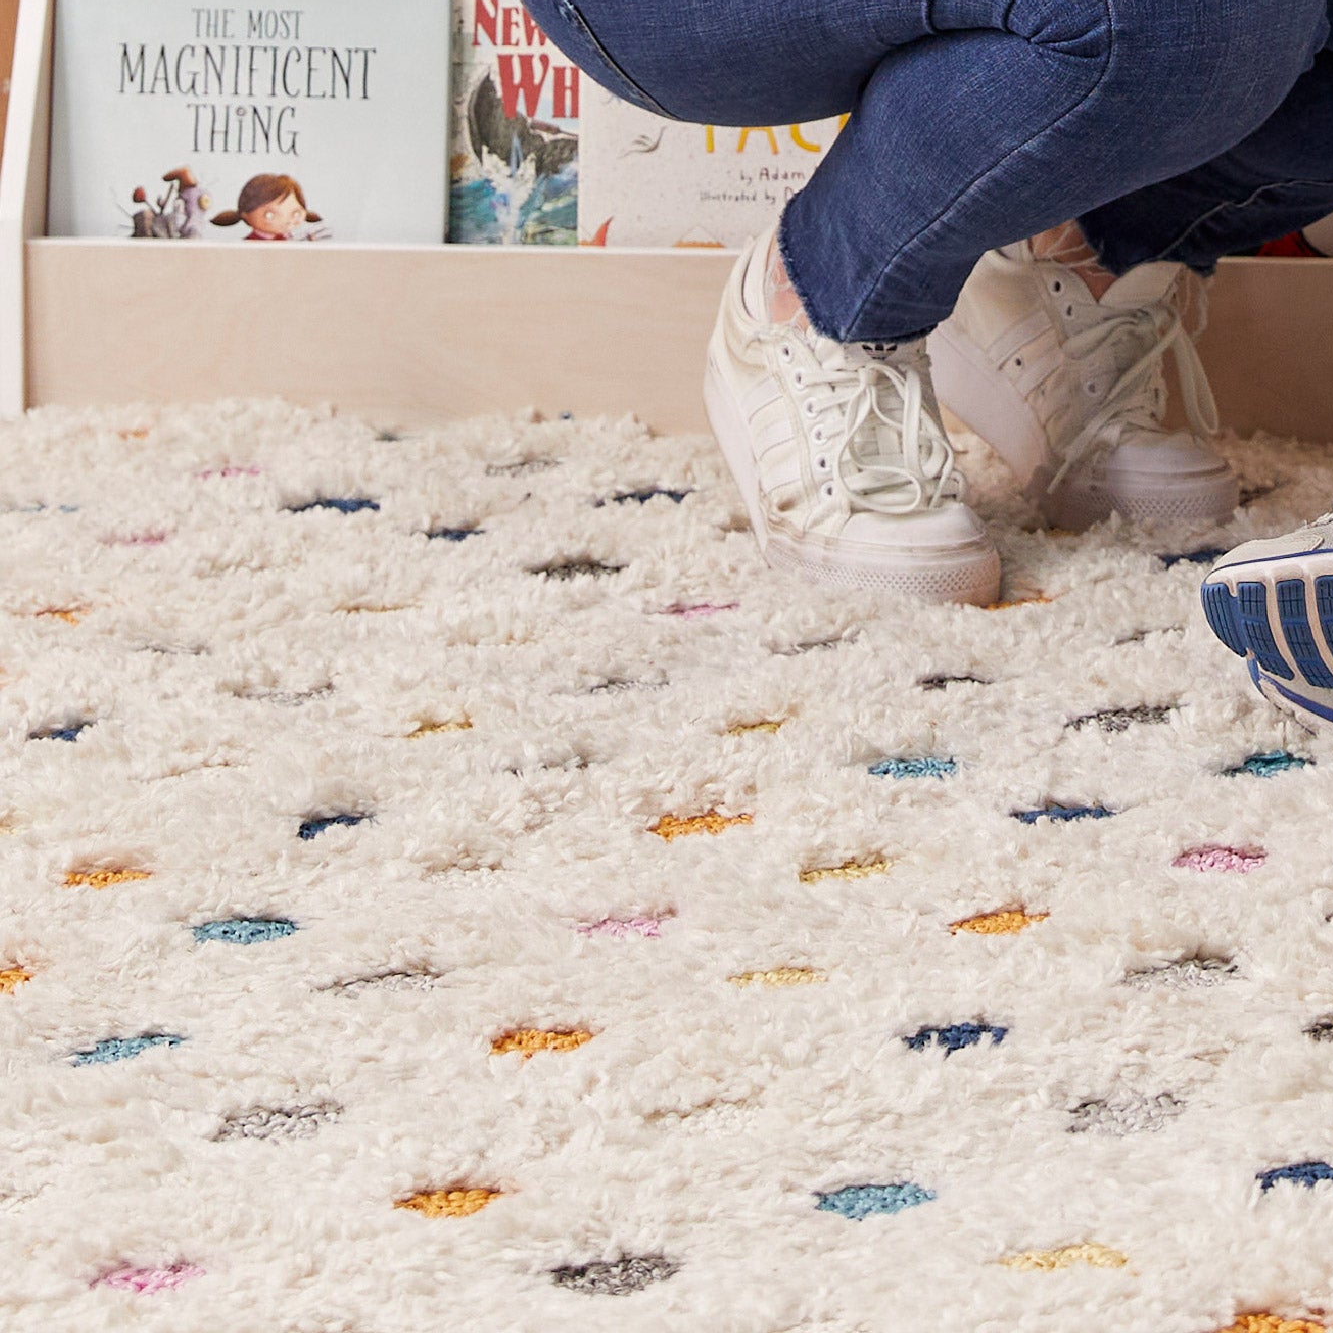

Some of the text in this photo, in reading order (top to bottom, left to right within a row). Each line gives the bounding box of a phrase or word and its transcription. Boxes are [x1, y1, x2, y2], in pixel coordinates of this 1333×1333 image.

[191, 8, 304, 40] THE MOST
[119, 42, 378, 100] MAGNIFICENT
[759, 167, 806, 181] Adam
